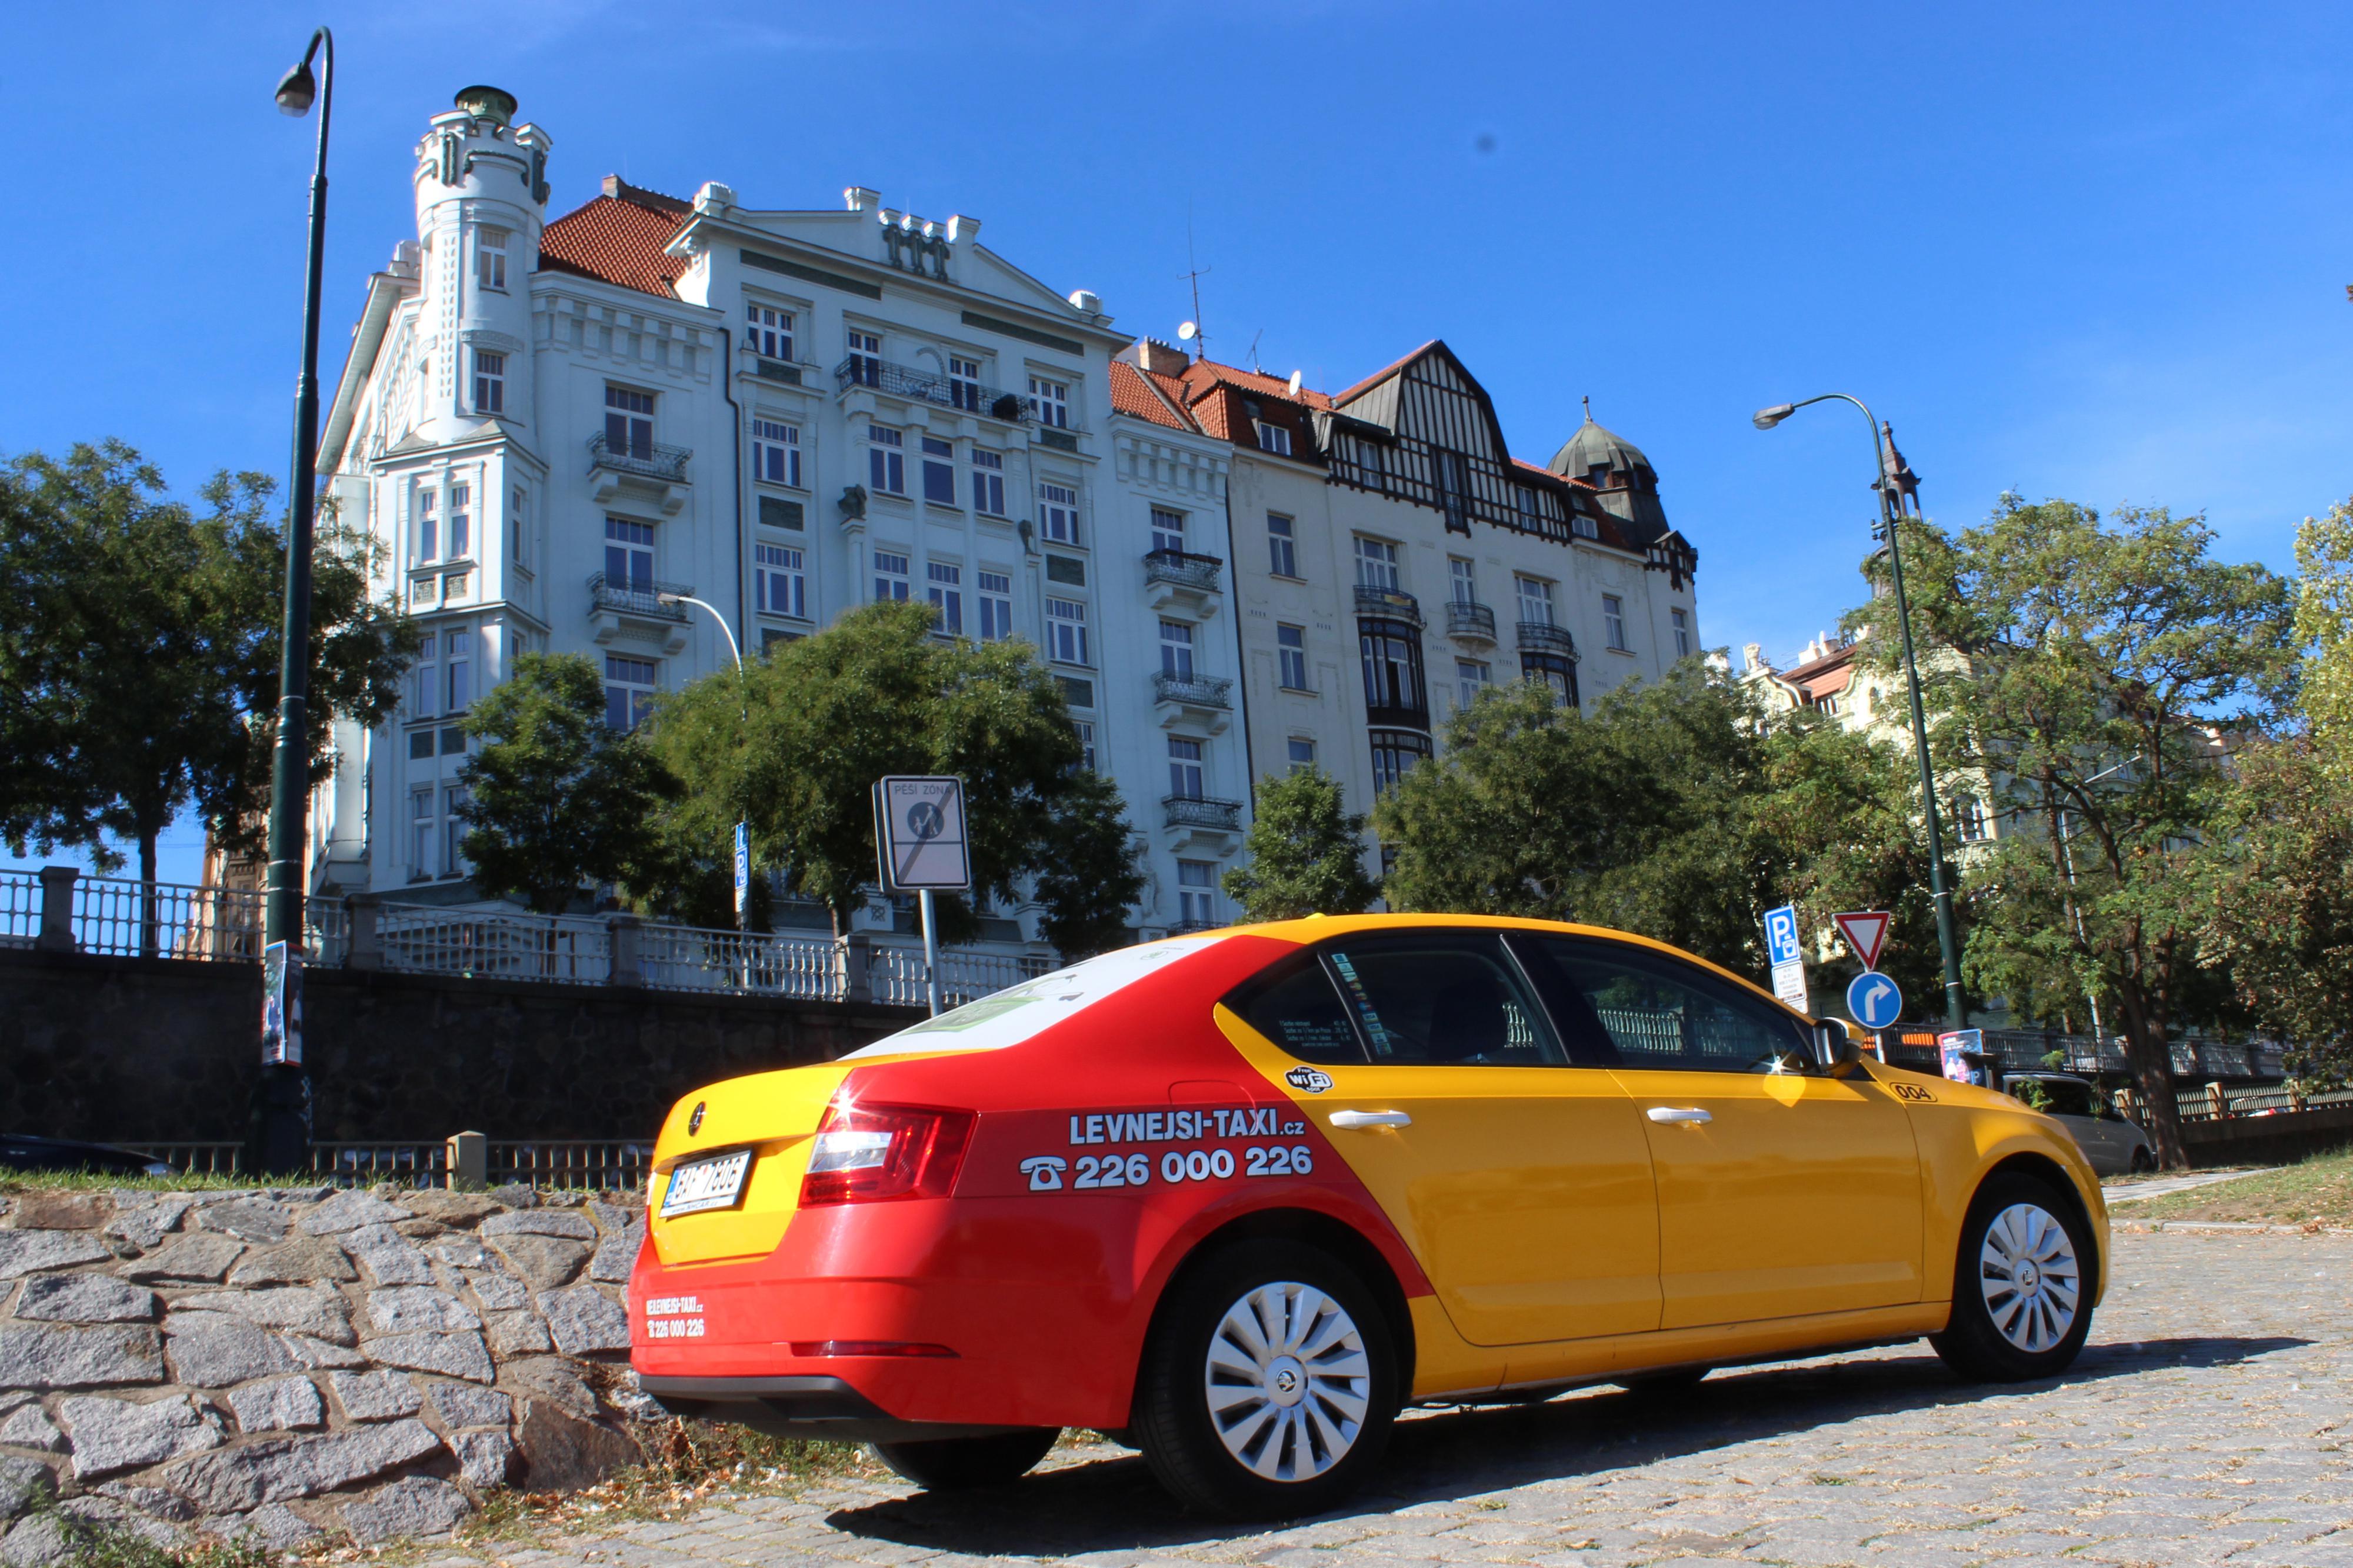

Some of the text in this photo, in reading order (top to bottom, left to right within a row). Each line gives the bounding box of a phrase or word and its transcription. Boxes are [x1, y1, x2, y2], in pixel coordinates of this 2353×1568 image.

[894, 783, 952, 795] PĚŠÍ ZÓNA
[1772, 915, 1790, 948] P
[1895, 1085, 1931, 1100] 004
[1073, 1145, 1314, 1190] 226 000 226
[655, 1318, 705, 1338] 226 000 226
